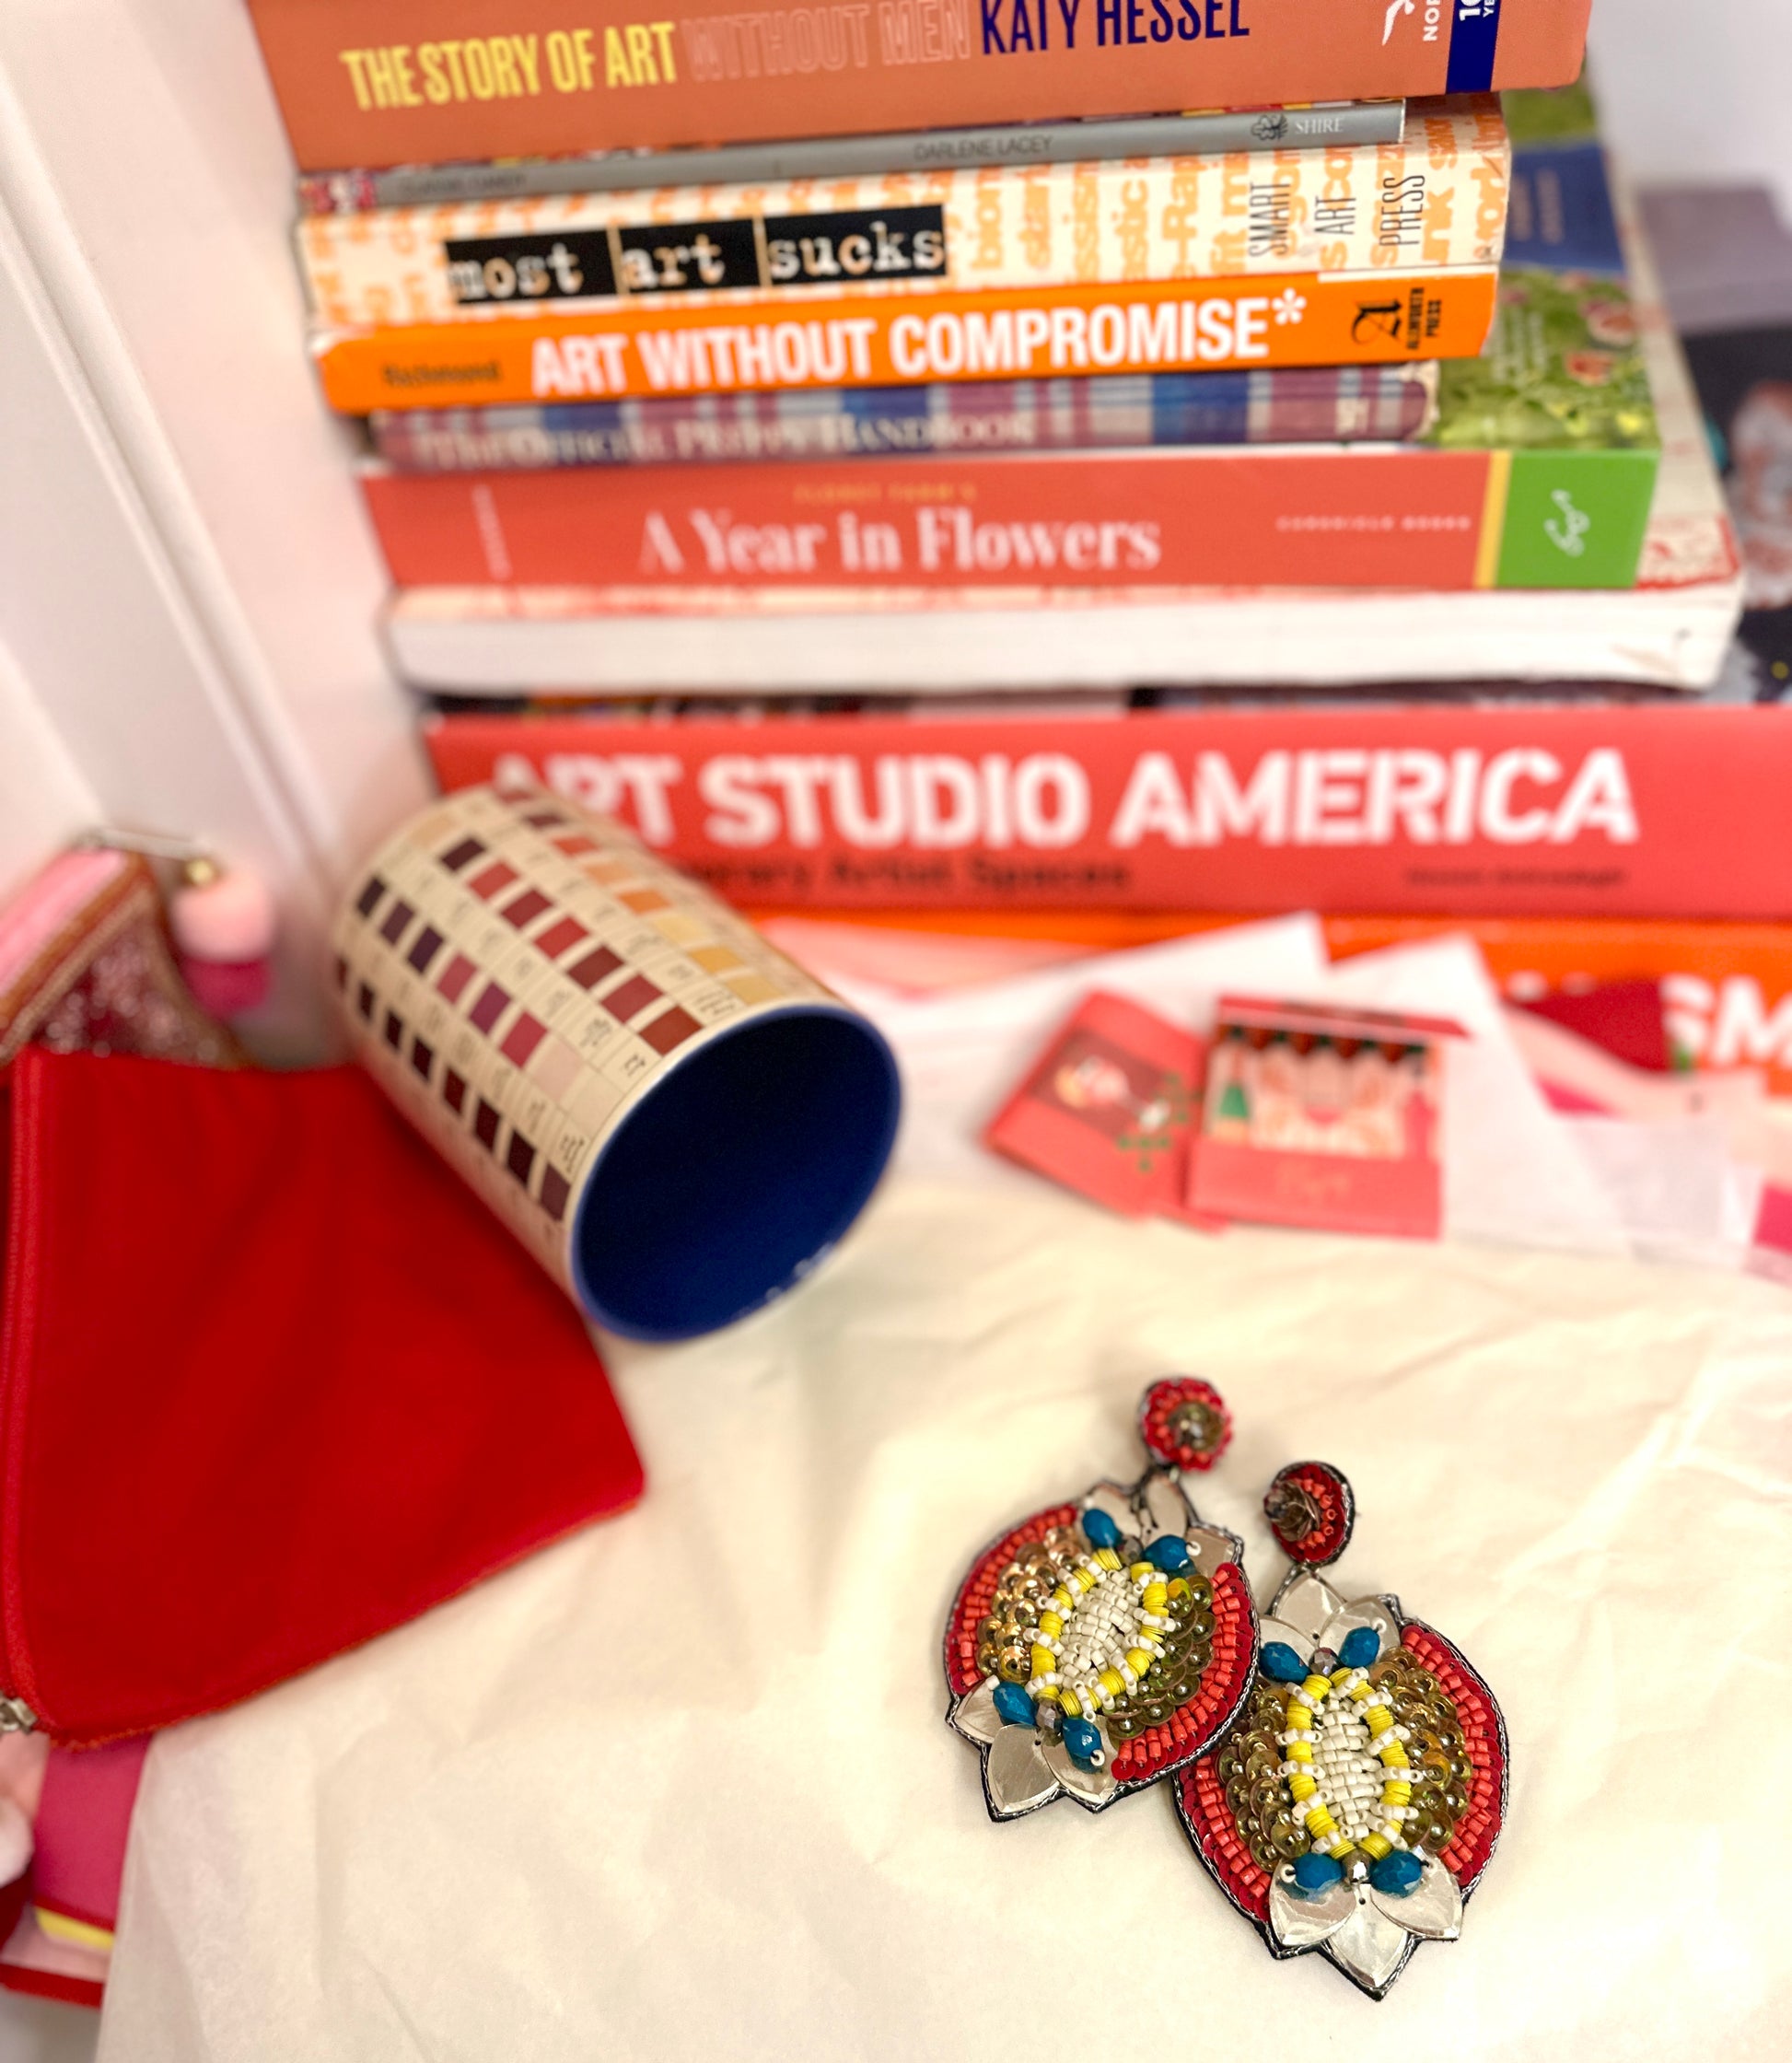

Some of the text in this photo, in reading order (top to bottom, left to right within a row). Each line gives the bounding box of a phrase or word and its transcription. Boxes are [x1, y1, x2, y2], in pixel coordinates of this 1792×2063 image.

[339, 0, 1251, 111] THE STORY OF ART WITHOUT MEN KATY HESSEL
[913, 134, 1054, 162] DARLENE LACEY
[1295, 116, 1344, 136] SHIRE
[1248, 181, 1291, 258] SMART
[1314, 195, 1357, 236] ART
[1379, 174, 1426, 248] PRESS
[448, 241, 585, 300] most
[620, 232, 726, 289] art
[766, 221, 946, 280] sucks
[531, 333, 629, 398] ART
[637, 319, 879, 391] WITHOUT
[641, 507, 1162, 574] A Year in Flowers
[697, 753, 1091, 850] STUDIO
[1109, 747, 1640, 848] AMERICA
